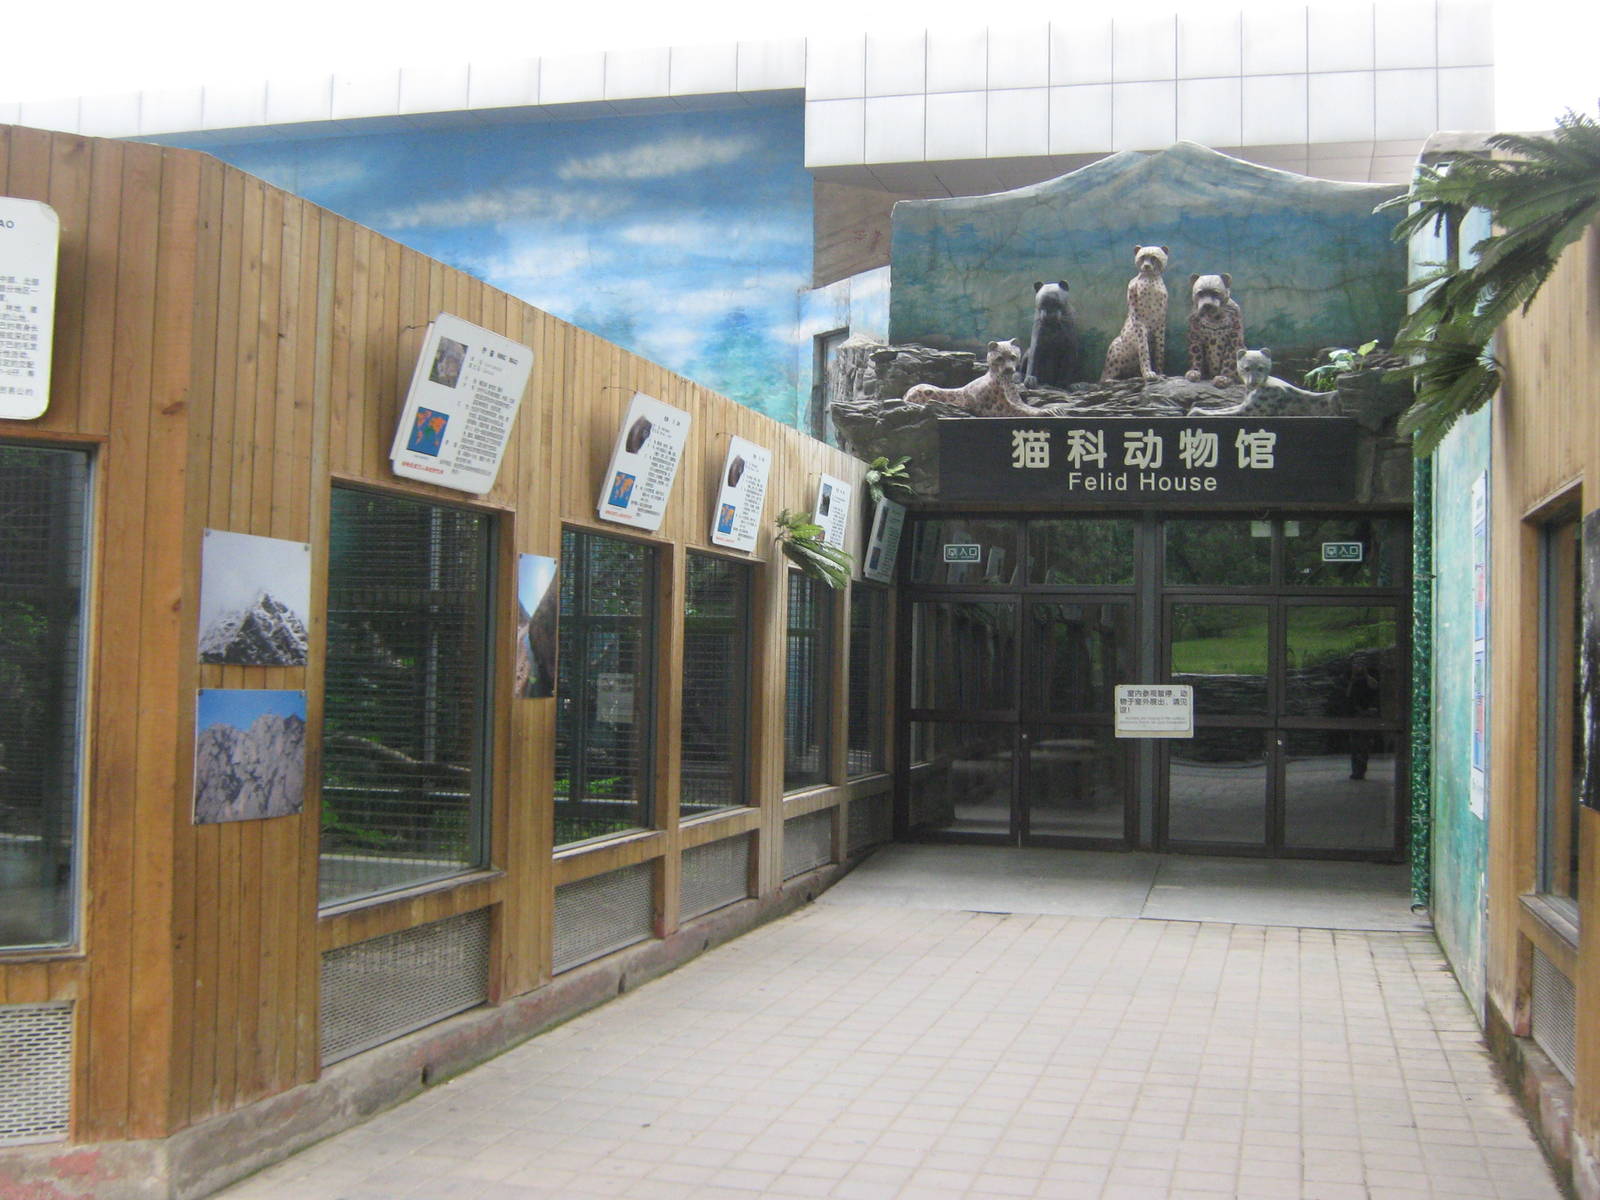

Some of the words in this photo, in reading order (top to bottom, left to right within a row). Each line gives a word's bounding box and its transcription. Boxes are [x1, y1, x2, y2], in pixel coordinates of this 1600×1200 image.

[1011, 429, 1276, 470] 猫科动物馆
[1068, 472, 1128, 491] Felid
[1139, 472, 1218, 492] House
